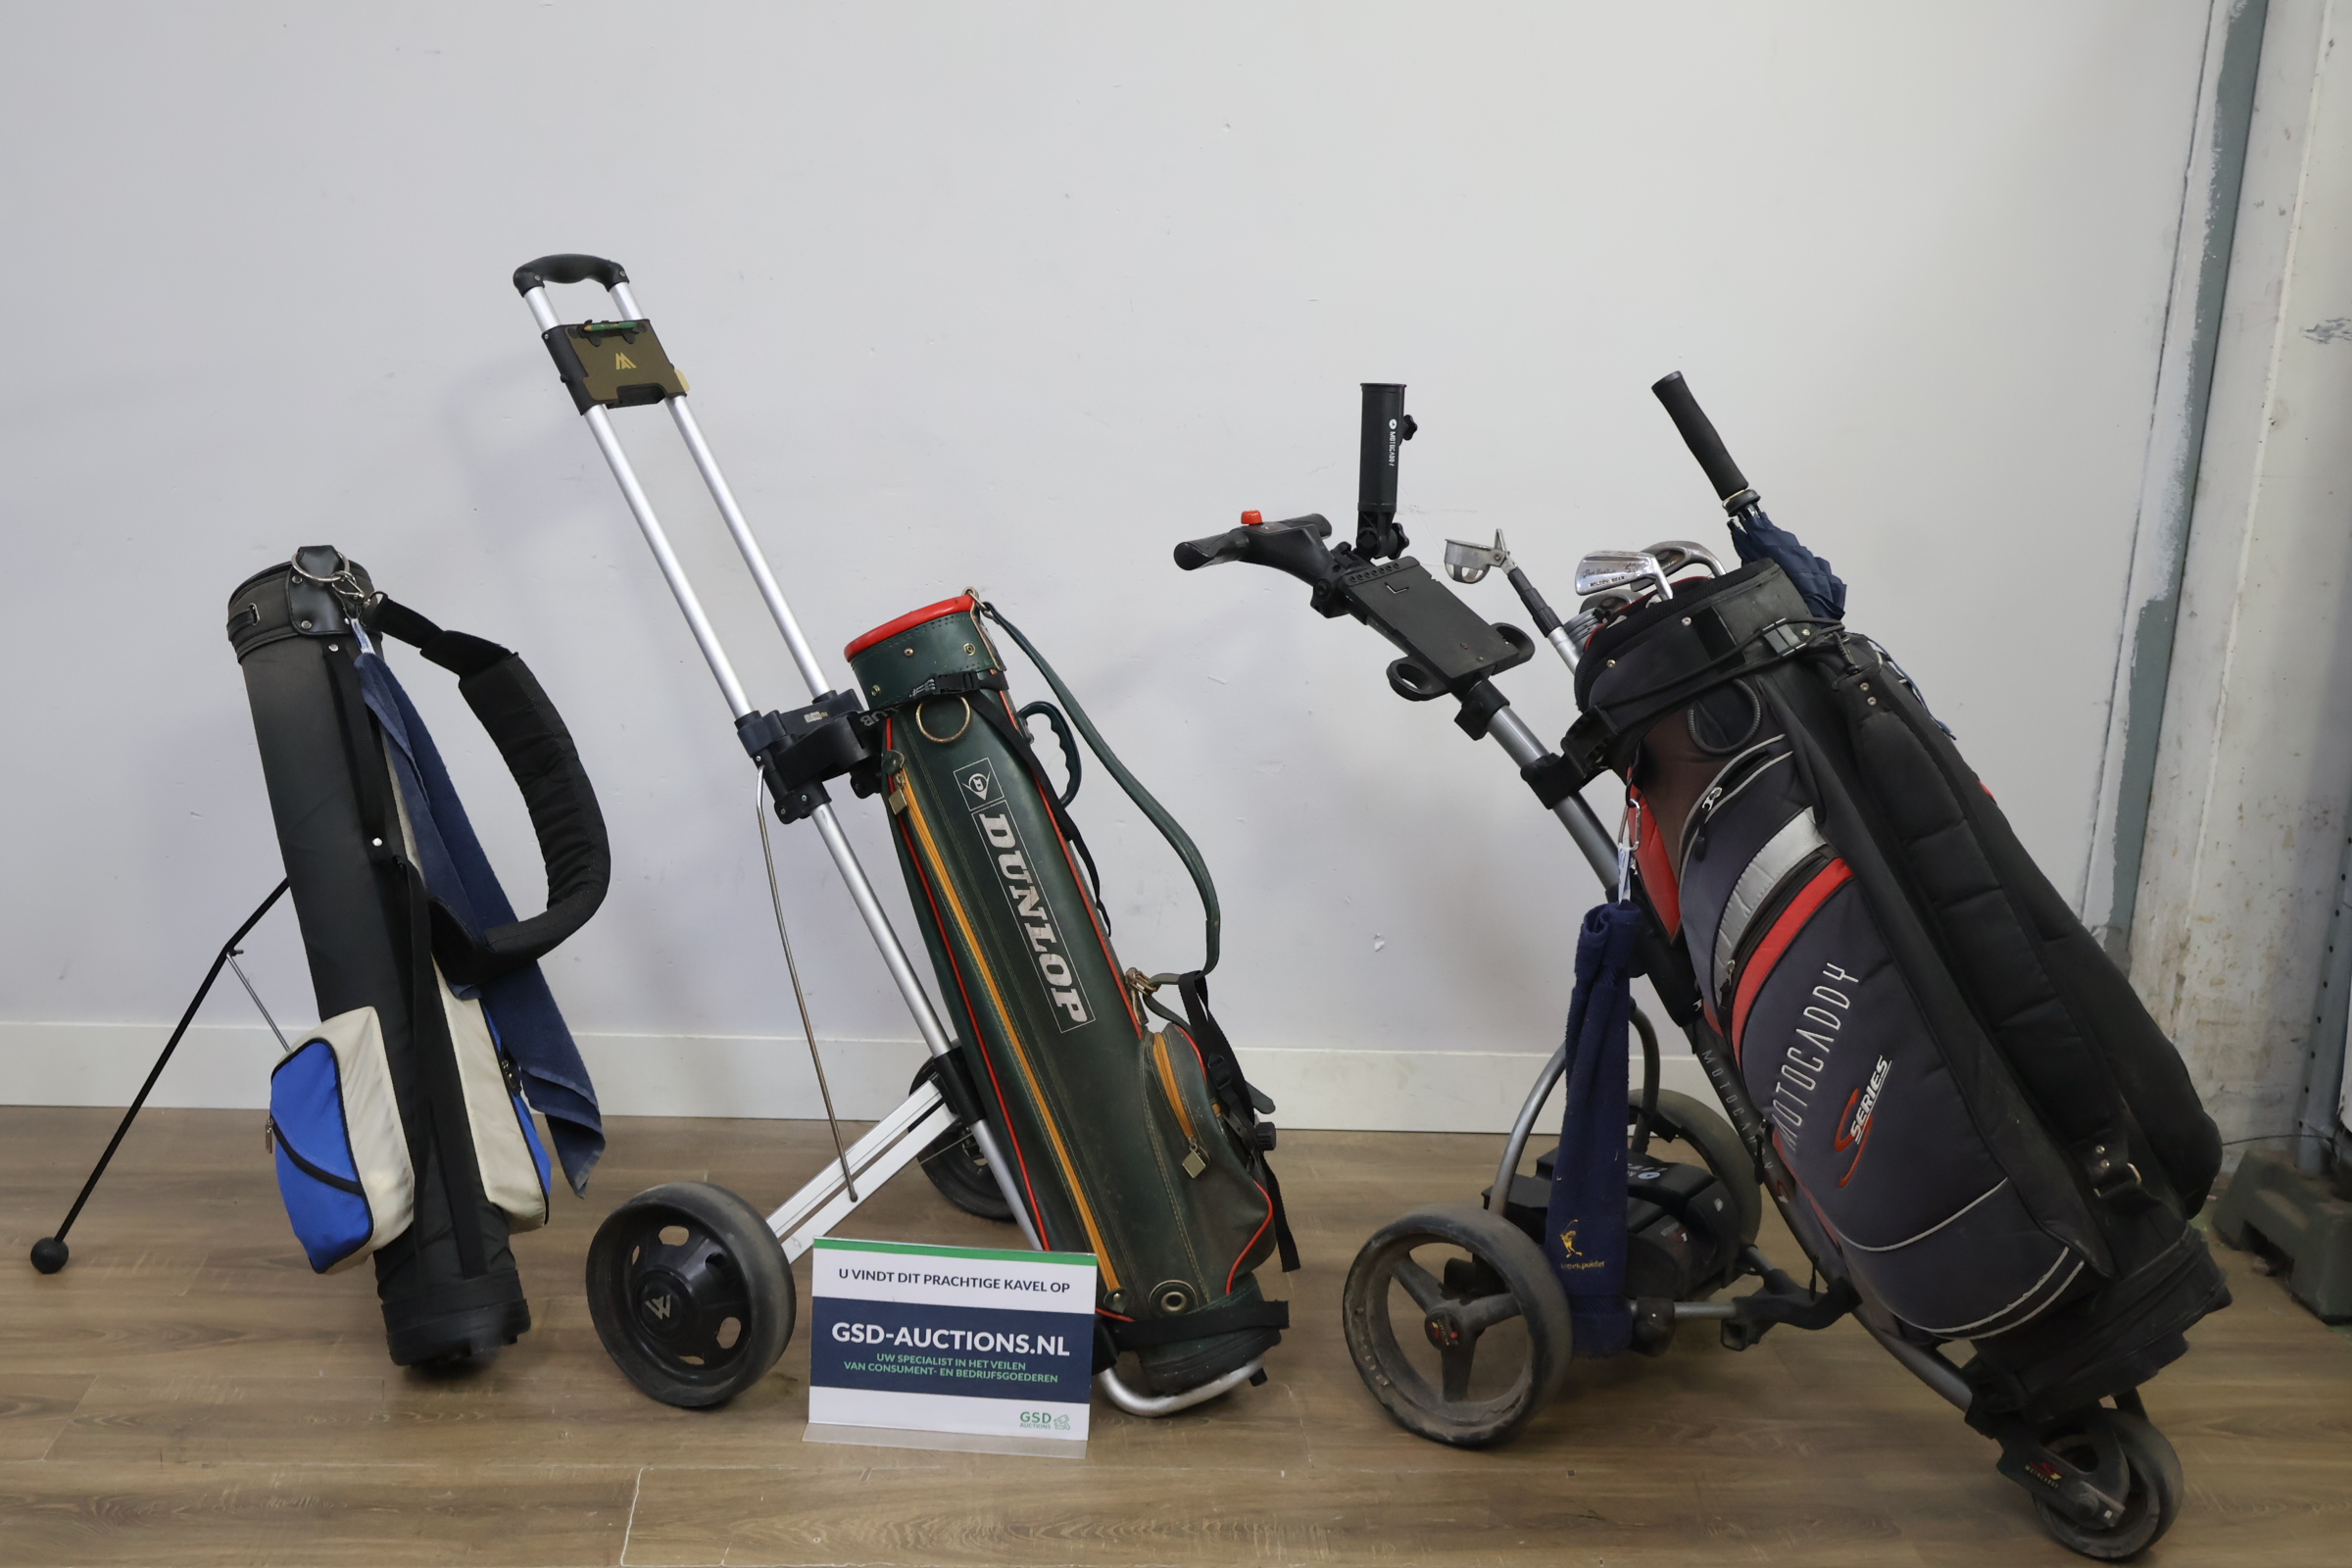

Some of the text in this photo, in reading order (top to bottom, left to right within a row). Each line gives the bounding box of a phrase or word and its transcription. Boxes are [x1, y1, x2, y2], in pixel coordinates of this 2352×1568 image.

[979, 813, 1088, 1022] DUNLOP
[1772, 962, 1859, 1152] MOTOCADDY
[1850, 1054, 1891, 1144] SERIES
[839, 1268, 1070, 1294] U VINDT DIT PRACHTIGE KAVEL OP
[832, 1322, 1070, 1356] GSD-AUCTIONS.NL
[844, 1361, 1058, 1383] VAN CONSUMENT- EN BEDRIJFSGOEDEREN
[876, 1352, 1026, 1371] UW SPECIALIST IN HET VEILEN
[1019, 1411, 1052, 1424] GSD
